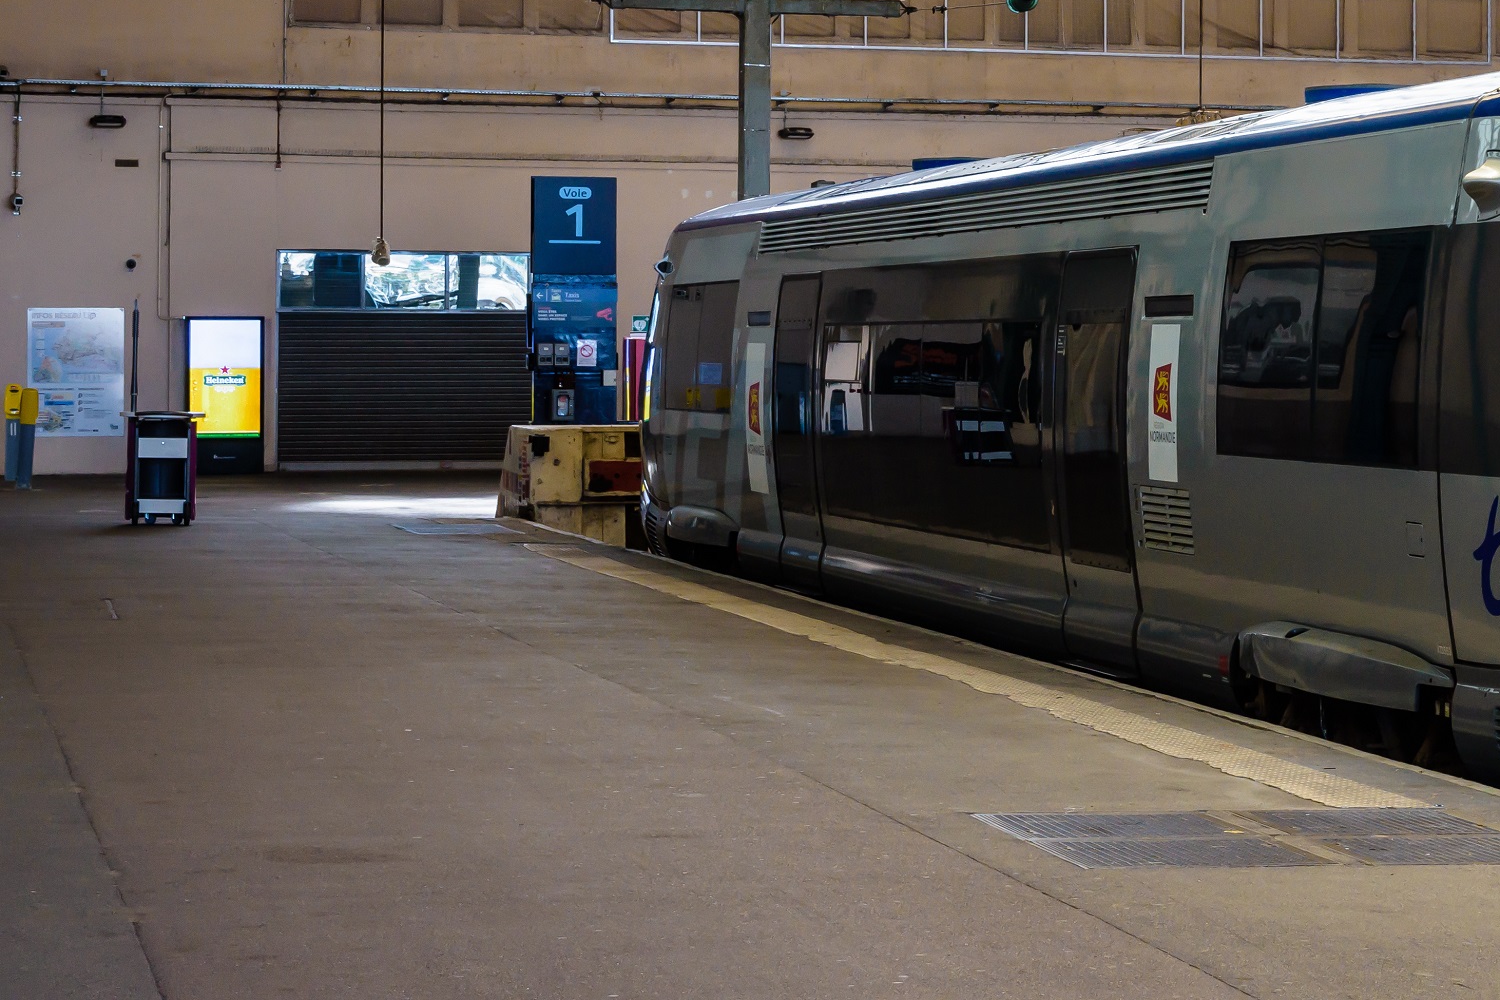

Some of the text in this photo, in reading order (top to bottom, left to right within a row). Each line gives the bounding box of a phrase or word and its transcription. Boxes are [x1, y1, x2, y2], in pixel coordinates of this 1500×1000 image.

[563, 188, 588, 198] Voie
[565, 204, 583, 237] 1
[205, 376, 245, 385] Heineken
